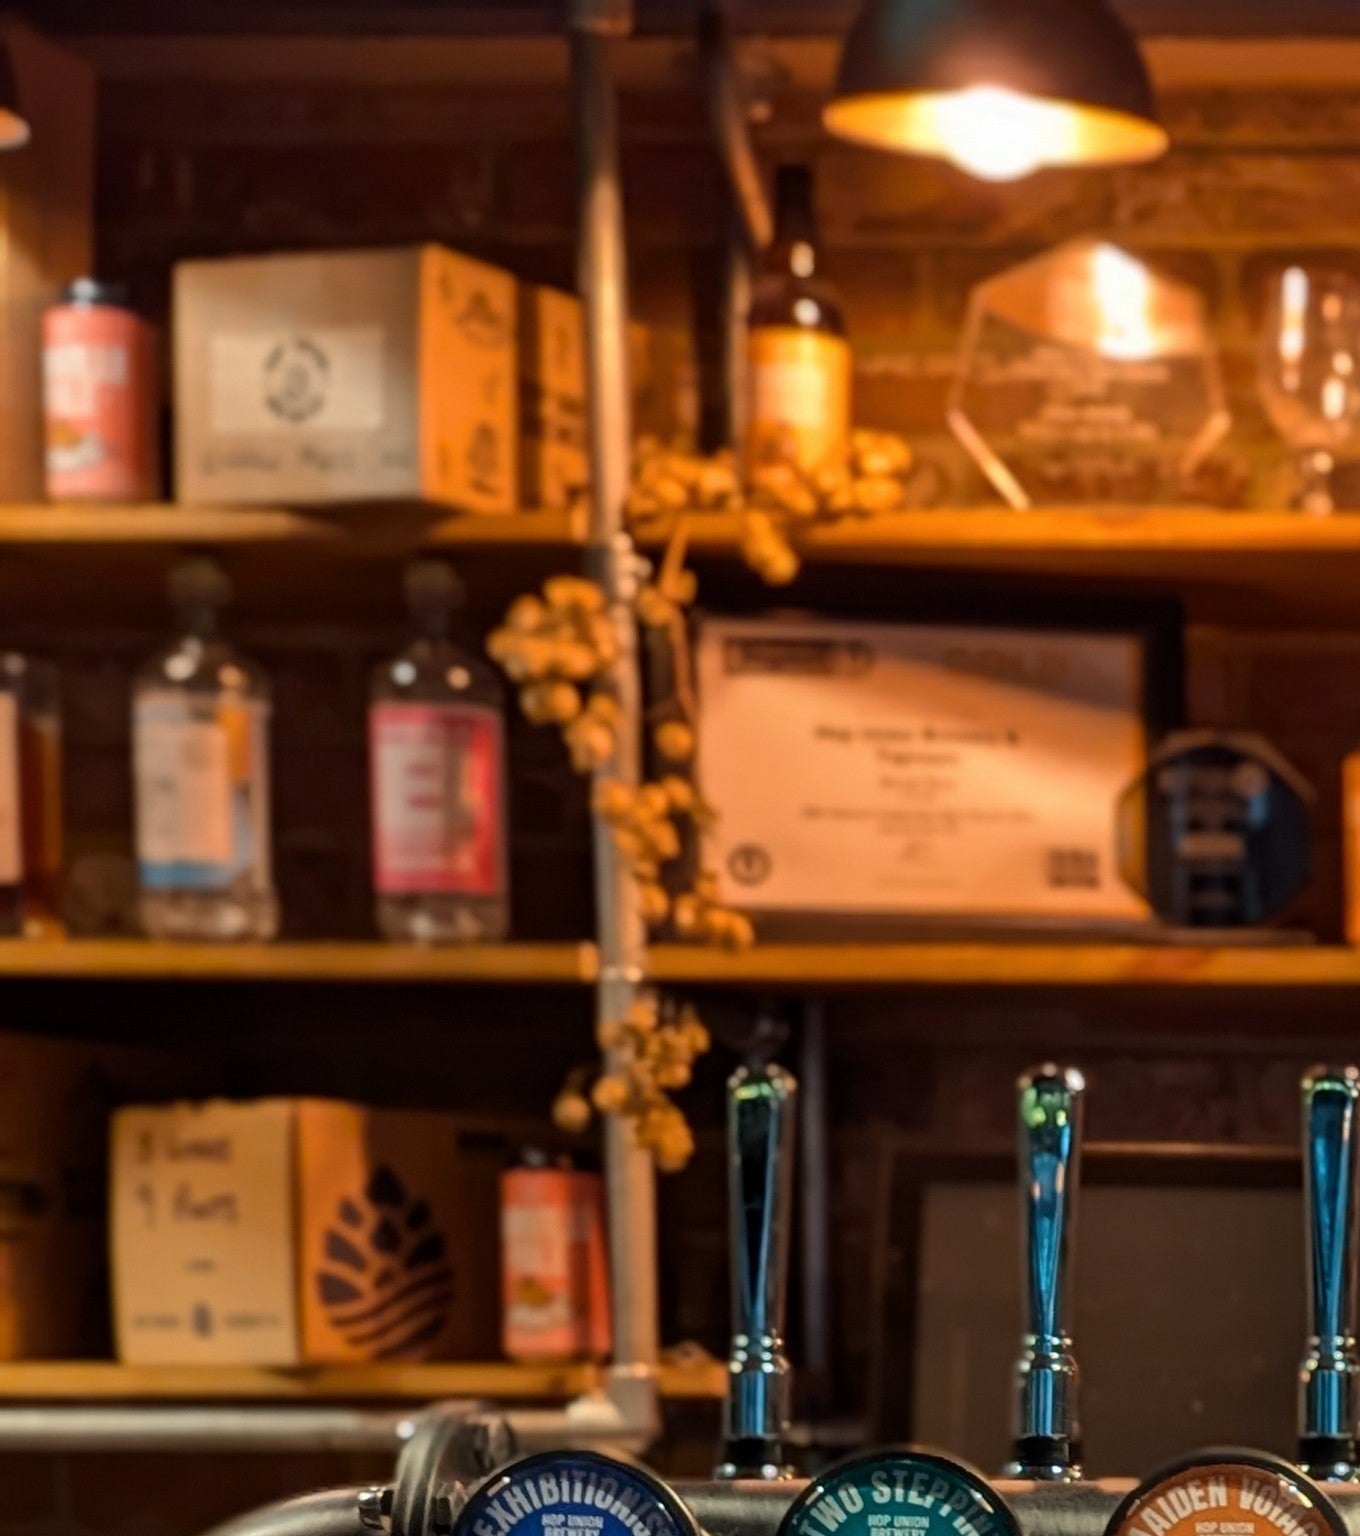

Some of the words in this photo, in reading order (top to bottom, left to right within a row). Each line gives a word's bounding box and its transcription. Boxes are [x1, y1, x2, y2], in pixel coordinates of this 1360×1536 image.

[541, 1513, 566, 1527] HOP
[567, 1514, 604, 1529] UNION
[867, 1514, 889, 1527] HOP
[893, 1514, 929, 1528] UNION
